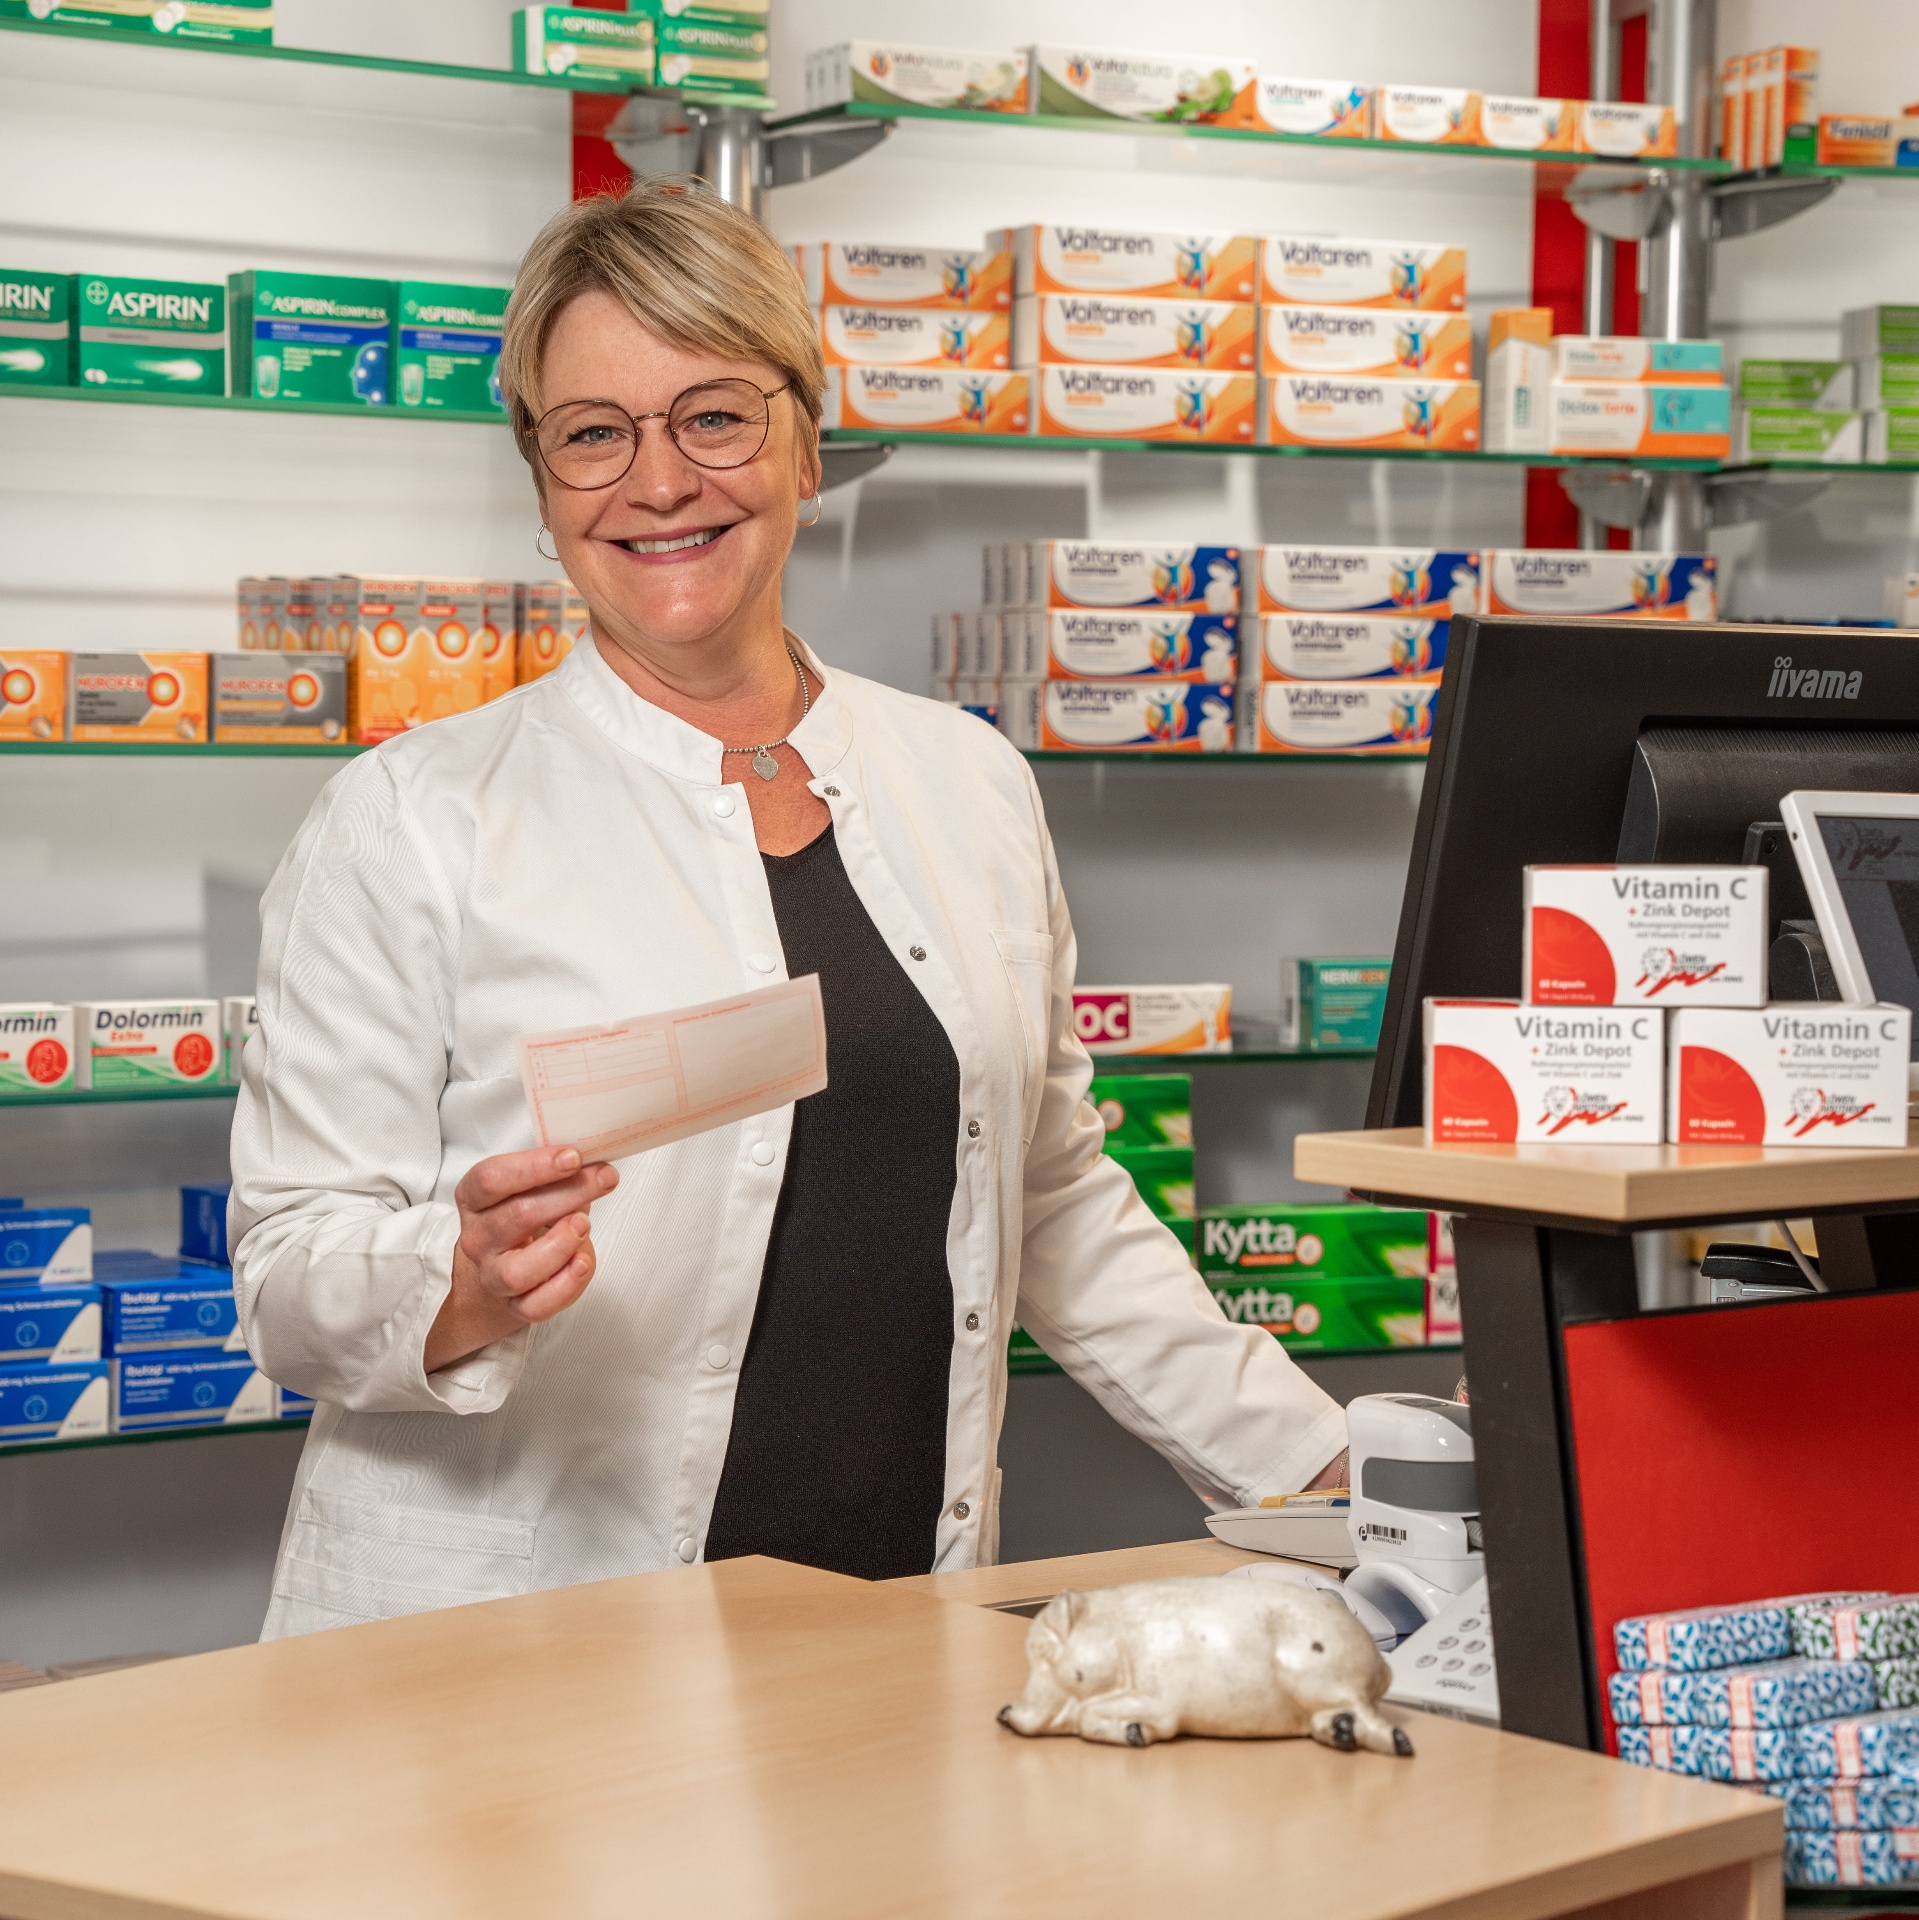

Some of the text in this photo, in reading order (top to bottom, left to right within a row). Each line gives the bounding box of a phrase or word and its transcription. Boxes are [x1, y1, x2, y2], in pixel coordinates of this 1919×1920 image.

[1055, 227, 1154, 254] Voltaren
[842, 245, 926, 269] Voltaren
[1278, 240, 1372, 268] Voltaren
[0, 282, 51, 311] IRIN
[107, 291, 210, 322] ASPIRIN
[839, 308, 923, 332] Voltaren
[1059, 299, 1156, 326] Voltaren
[1282, 310, 1375, 336] Voltaren
[860, 369, 942, 391] Voltaren
[1058, 369, 1155, 396] Voltaren
[1288, 380, 1383, 405] Voltaren
[1062, 546, 1144, 567] Voltaren
[1283, 551, 1369, 572] Voltaren
[1510, 556, 1591, 577] Voltaren
[1060, 615, 1142, 636] Voltaren
[1286, 620, 1370, 641] Voltaren
[77, 674, 148, 691] NUROFEN
[220, 677, 288, 694] NUROFEN
[1767, 656, 1863, 700] iiyama
[1055, 683, 1138, 705] Voltaren
[1284, 688, 1369, 709] Voltaren
[1612, 876, 1748, 900] Vitamin C
[1642, 903, 1676, 917] Zink
[1682, 904, 1731, 920] Depot
[0, 1010, 57, 1033] rmin
[96, 1006, 204, 1030] Dolormin
[1073, 1000, 1128, 1041] OC
[1515, 1016, 1650, 1040] Vitamin C
[1763, 1017, 1898, 1041] Vitamin C
[1544, 1043, 1579, 1057] Zink
[1583, 1044, 1632, 1059] Depot
[1792, 1044, 1826, 1058] Zink
[1831, 1045, 1881, 1061] Depot
[1204, 1218, 1296, 1265] Kytta
[1213, 1287, 1293, 1323] ytta
